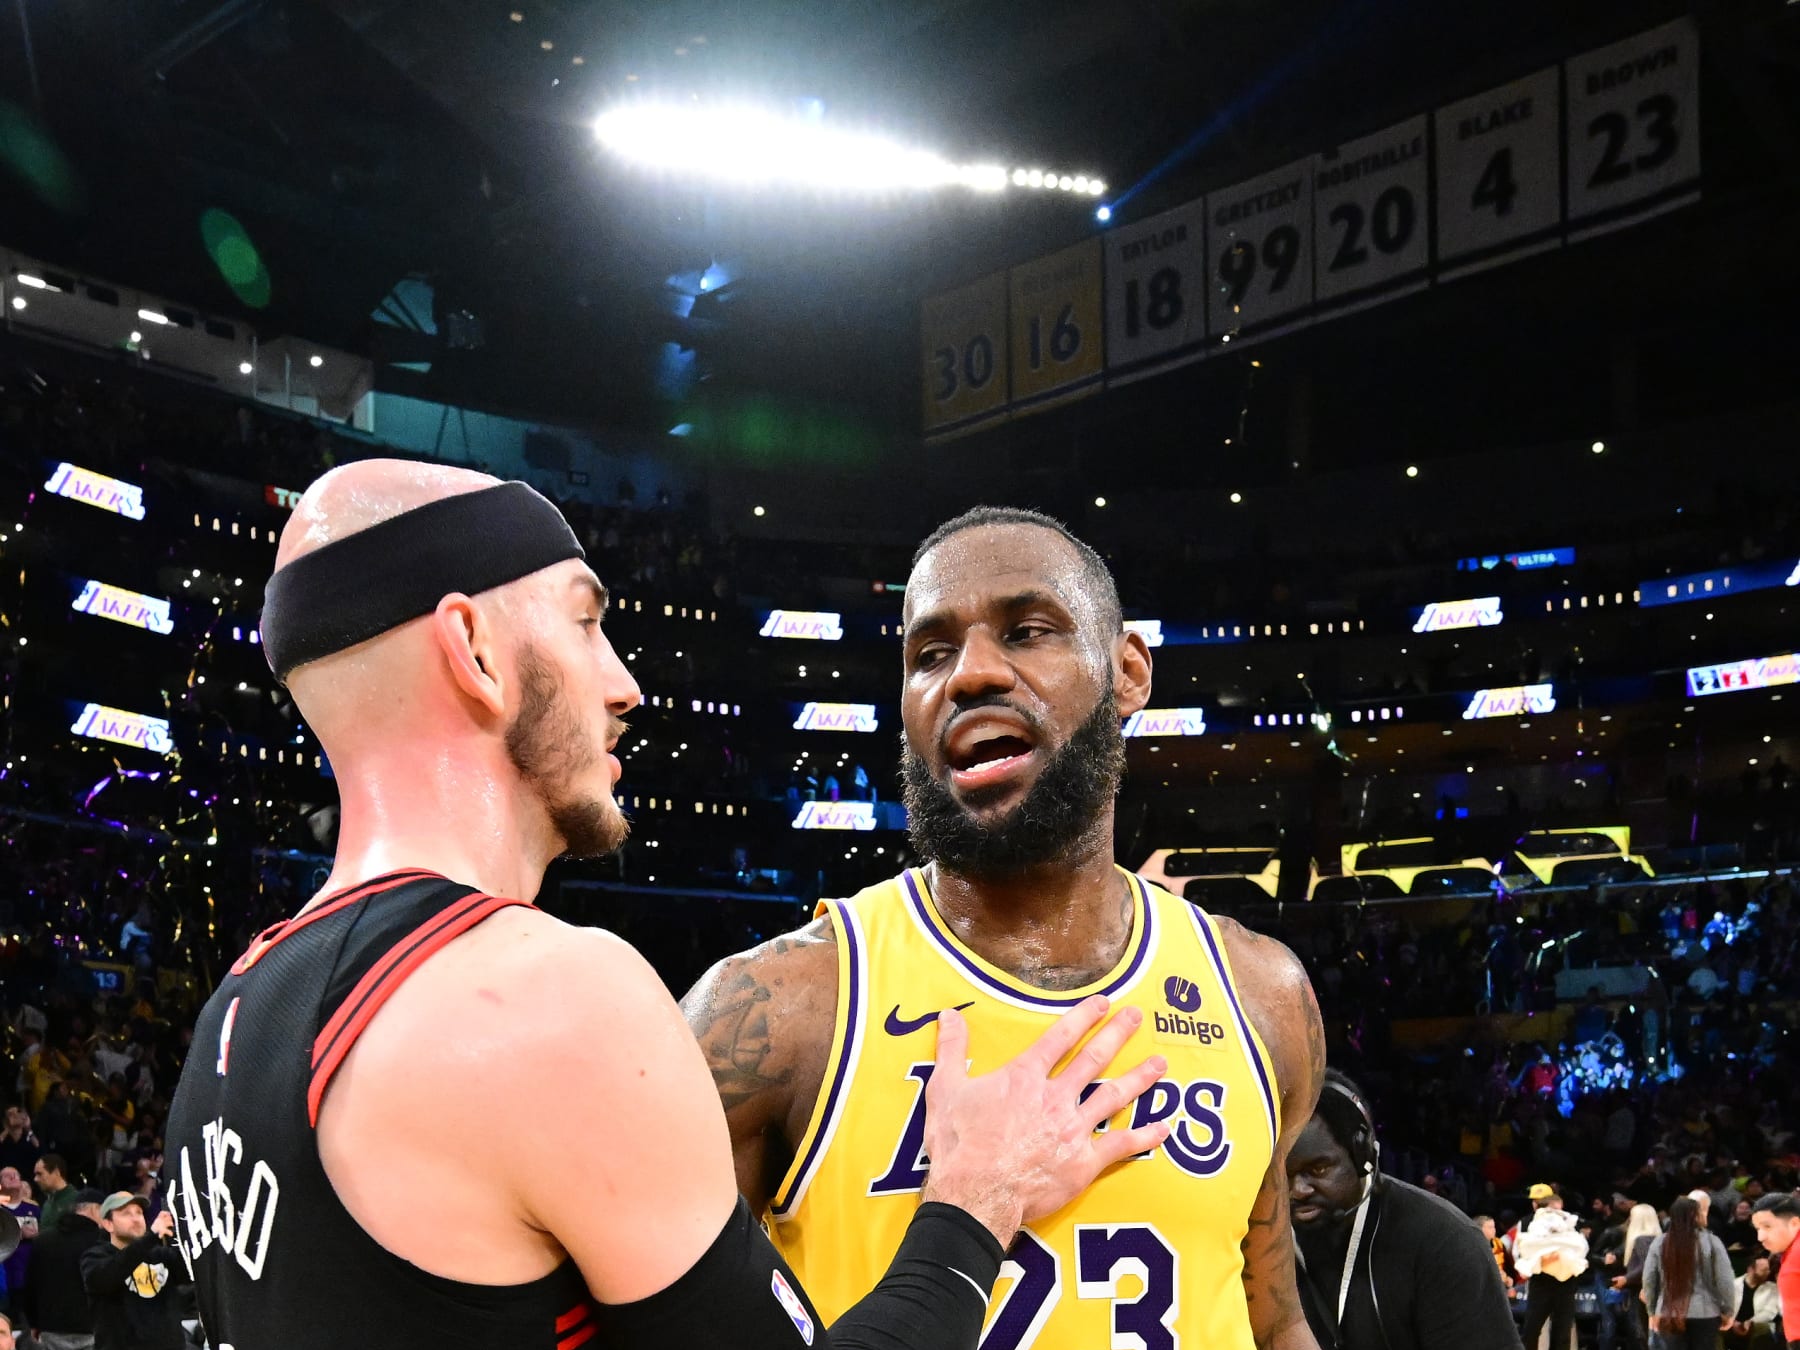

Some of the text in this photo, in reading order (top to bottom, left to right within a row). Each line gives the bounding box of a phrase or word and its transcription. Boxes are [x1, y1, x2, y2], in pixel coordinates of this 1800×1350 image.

[1586, 46, 1679, 95] BROWN
[1458, 98, 1533, 141] BLAKE
[1588, 94, 1680, 190] 23
[1471, 147, 1517, 216] 4
[1121, 225, 1188, 262] TAYLOR
[1329, 187, 1415, 273] 20
[1220, 225, 1301, 307] 99
[1126, 267, 1183, 338] 18
[929, 334, 994, 402] 30
[1030, 303, 1081, 371] 16
[1154, 1011, 1225, 1045] bibigo
